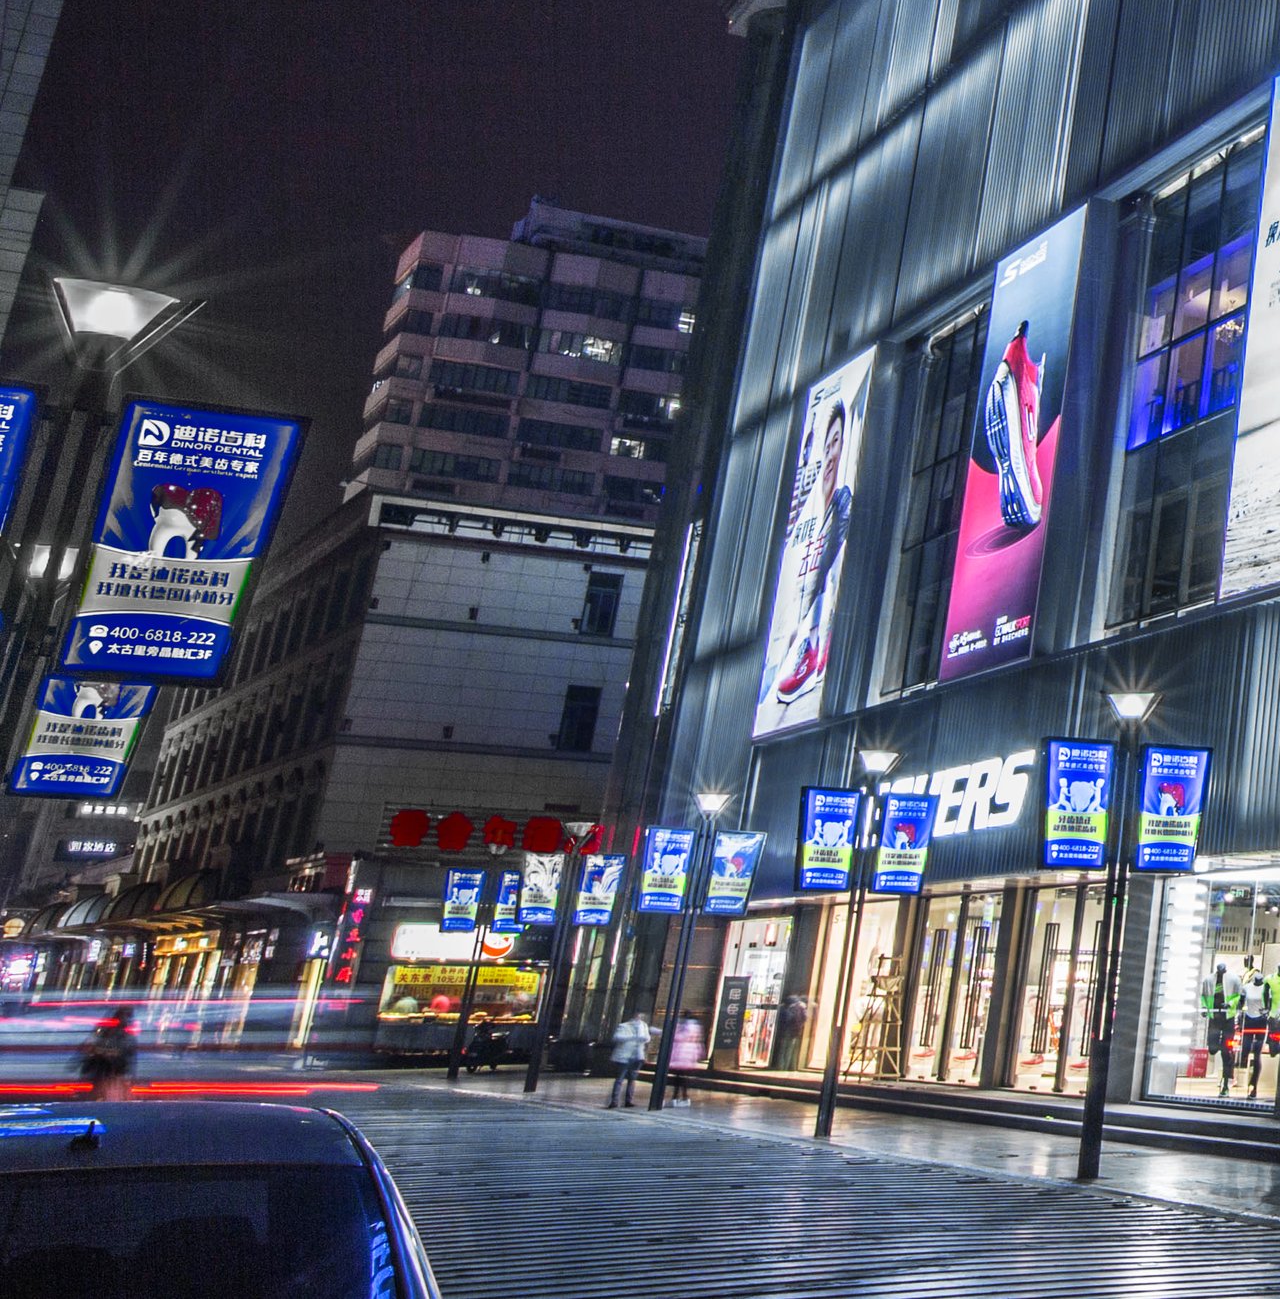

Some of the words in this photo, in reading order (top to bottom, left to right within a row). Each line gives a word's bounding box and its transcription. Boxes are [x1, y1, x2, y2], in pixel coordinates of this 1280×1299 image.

[173, 424, 267, 449] 迪诺齿科
[171, 440, 212, 452] DINOR
[214, 446, 264, 458] DENTAL
[138, 449, 260, 475] 百年德式美齿专家
[109, 561, 230, 587] 我是迪诺齿科
[96, 581, 235, 606] 我擅长德国种植牙
[110, 626, 216, 645] 400-6818-222
[107, 643, 212, 660] 太古里旁晶融汇3F
[399, 973, 432, 983] 关东煮
